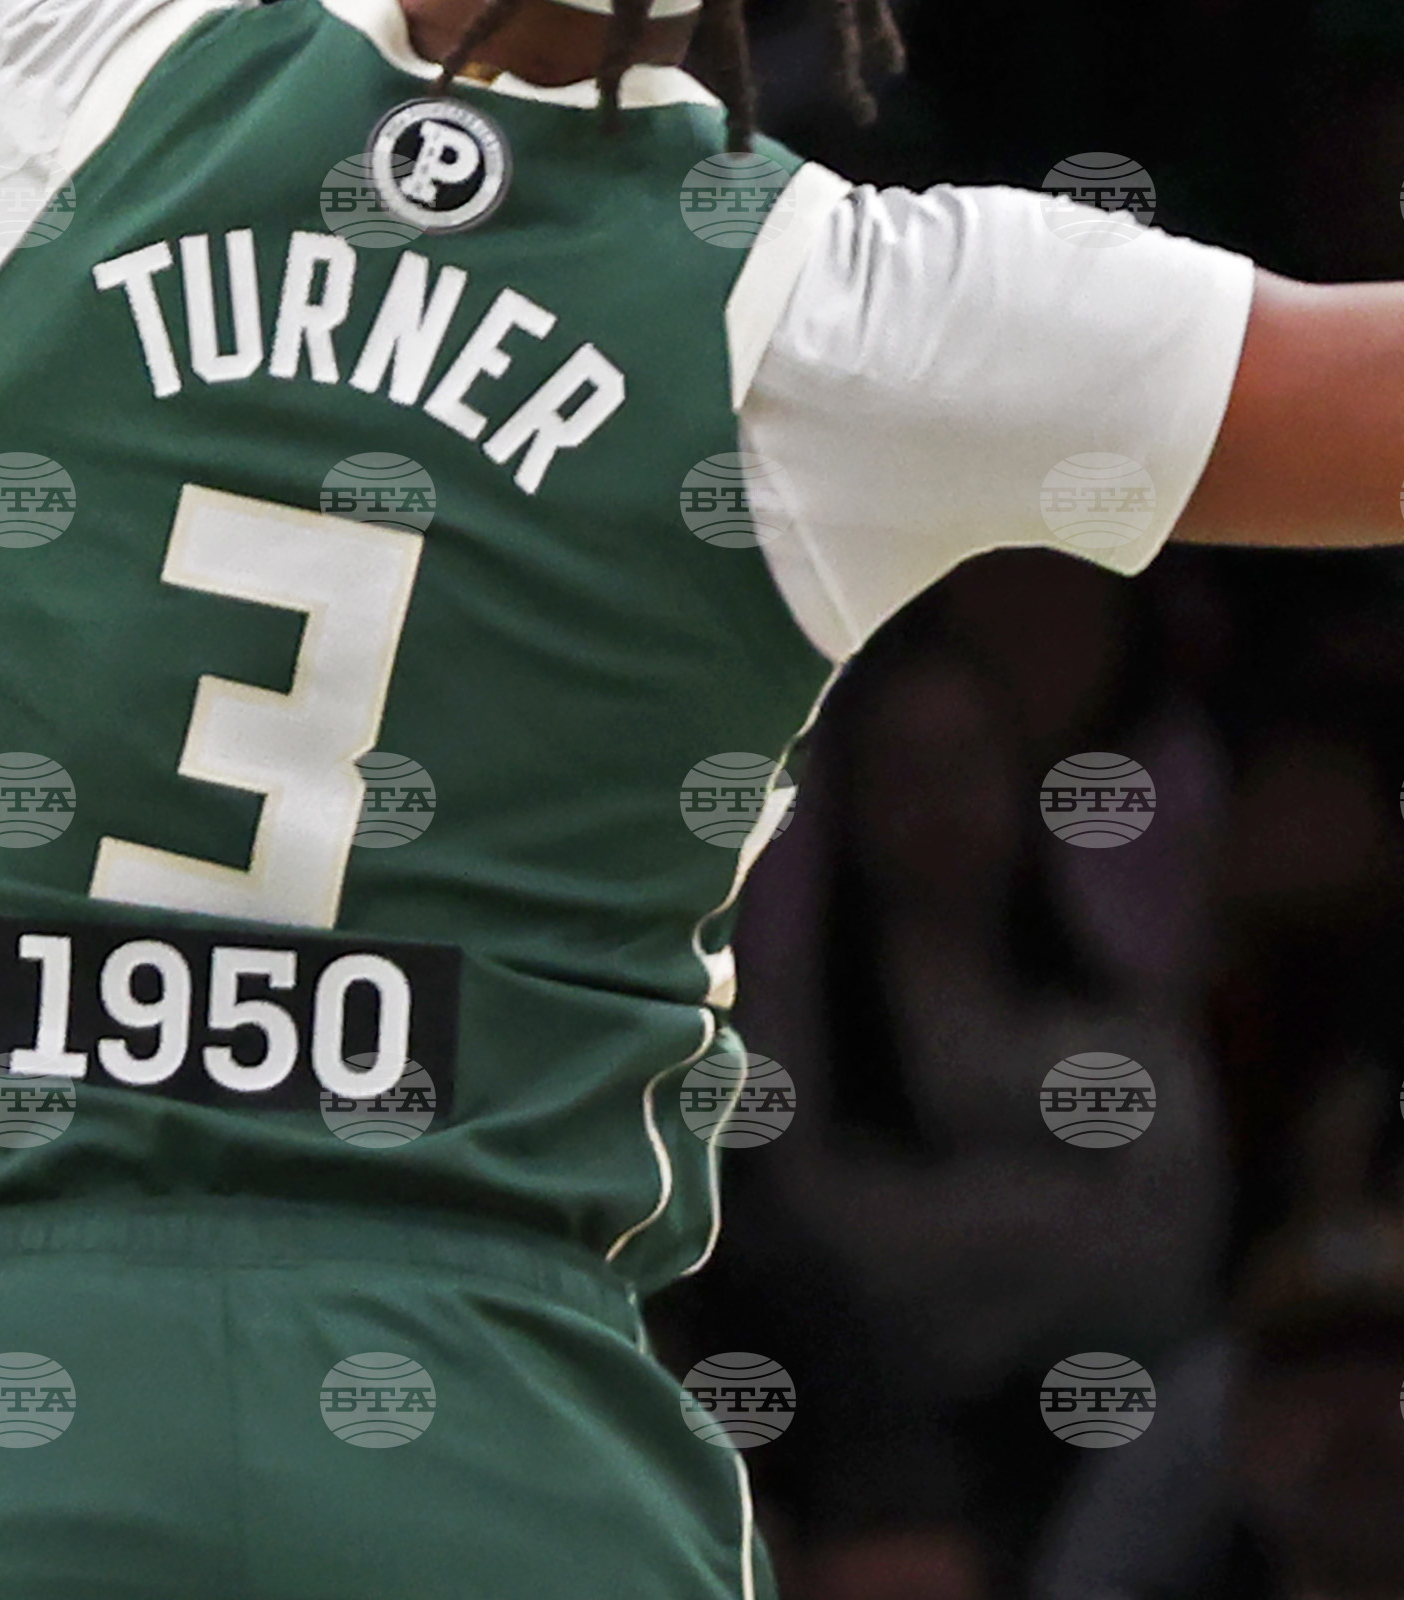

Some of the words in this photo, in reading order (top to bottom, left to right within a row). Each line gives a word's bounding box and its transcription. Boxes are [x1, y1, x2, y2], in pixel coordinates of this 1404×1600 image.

[92, 227, 626, 496] TURNER
[89, 483, 425, 930] 3
[9, 933, 412, 1100] 1950
